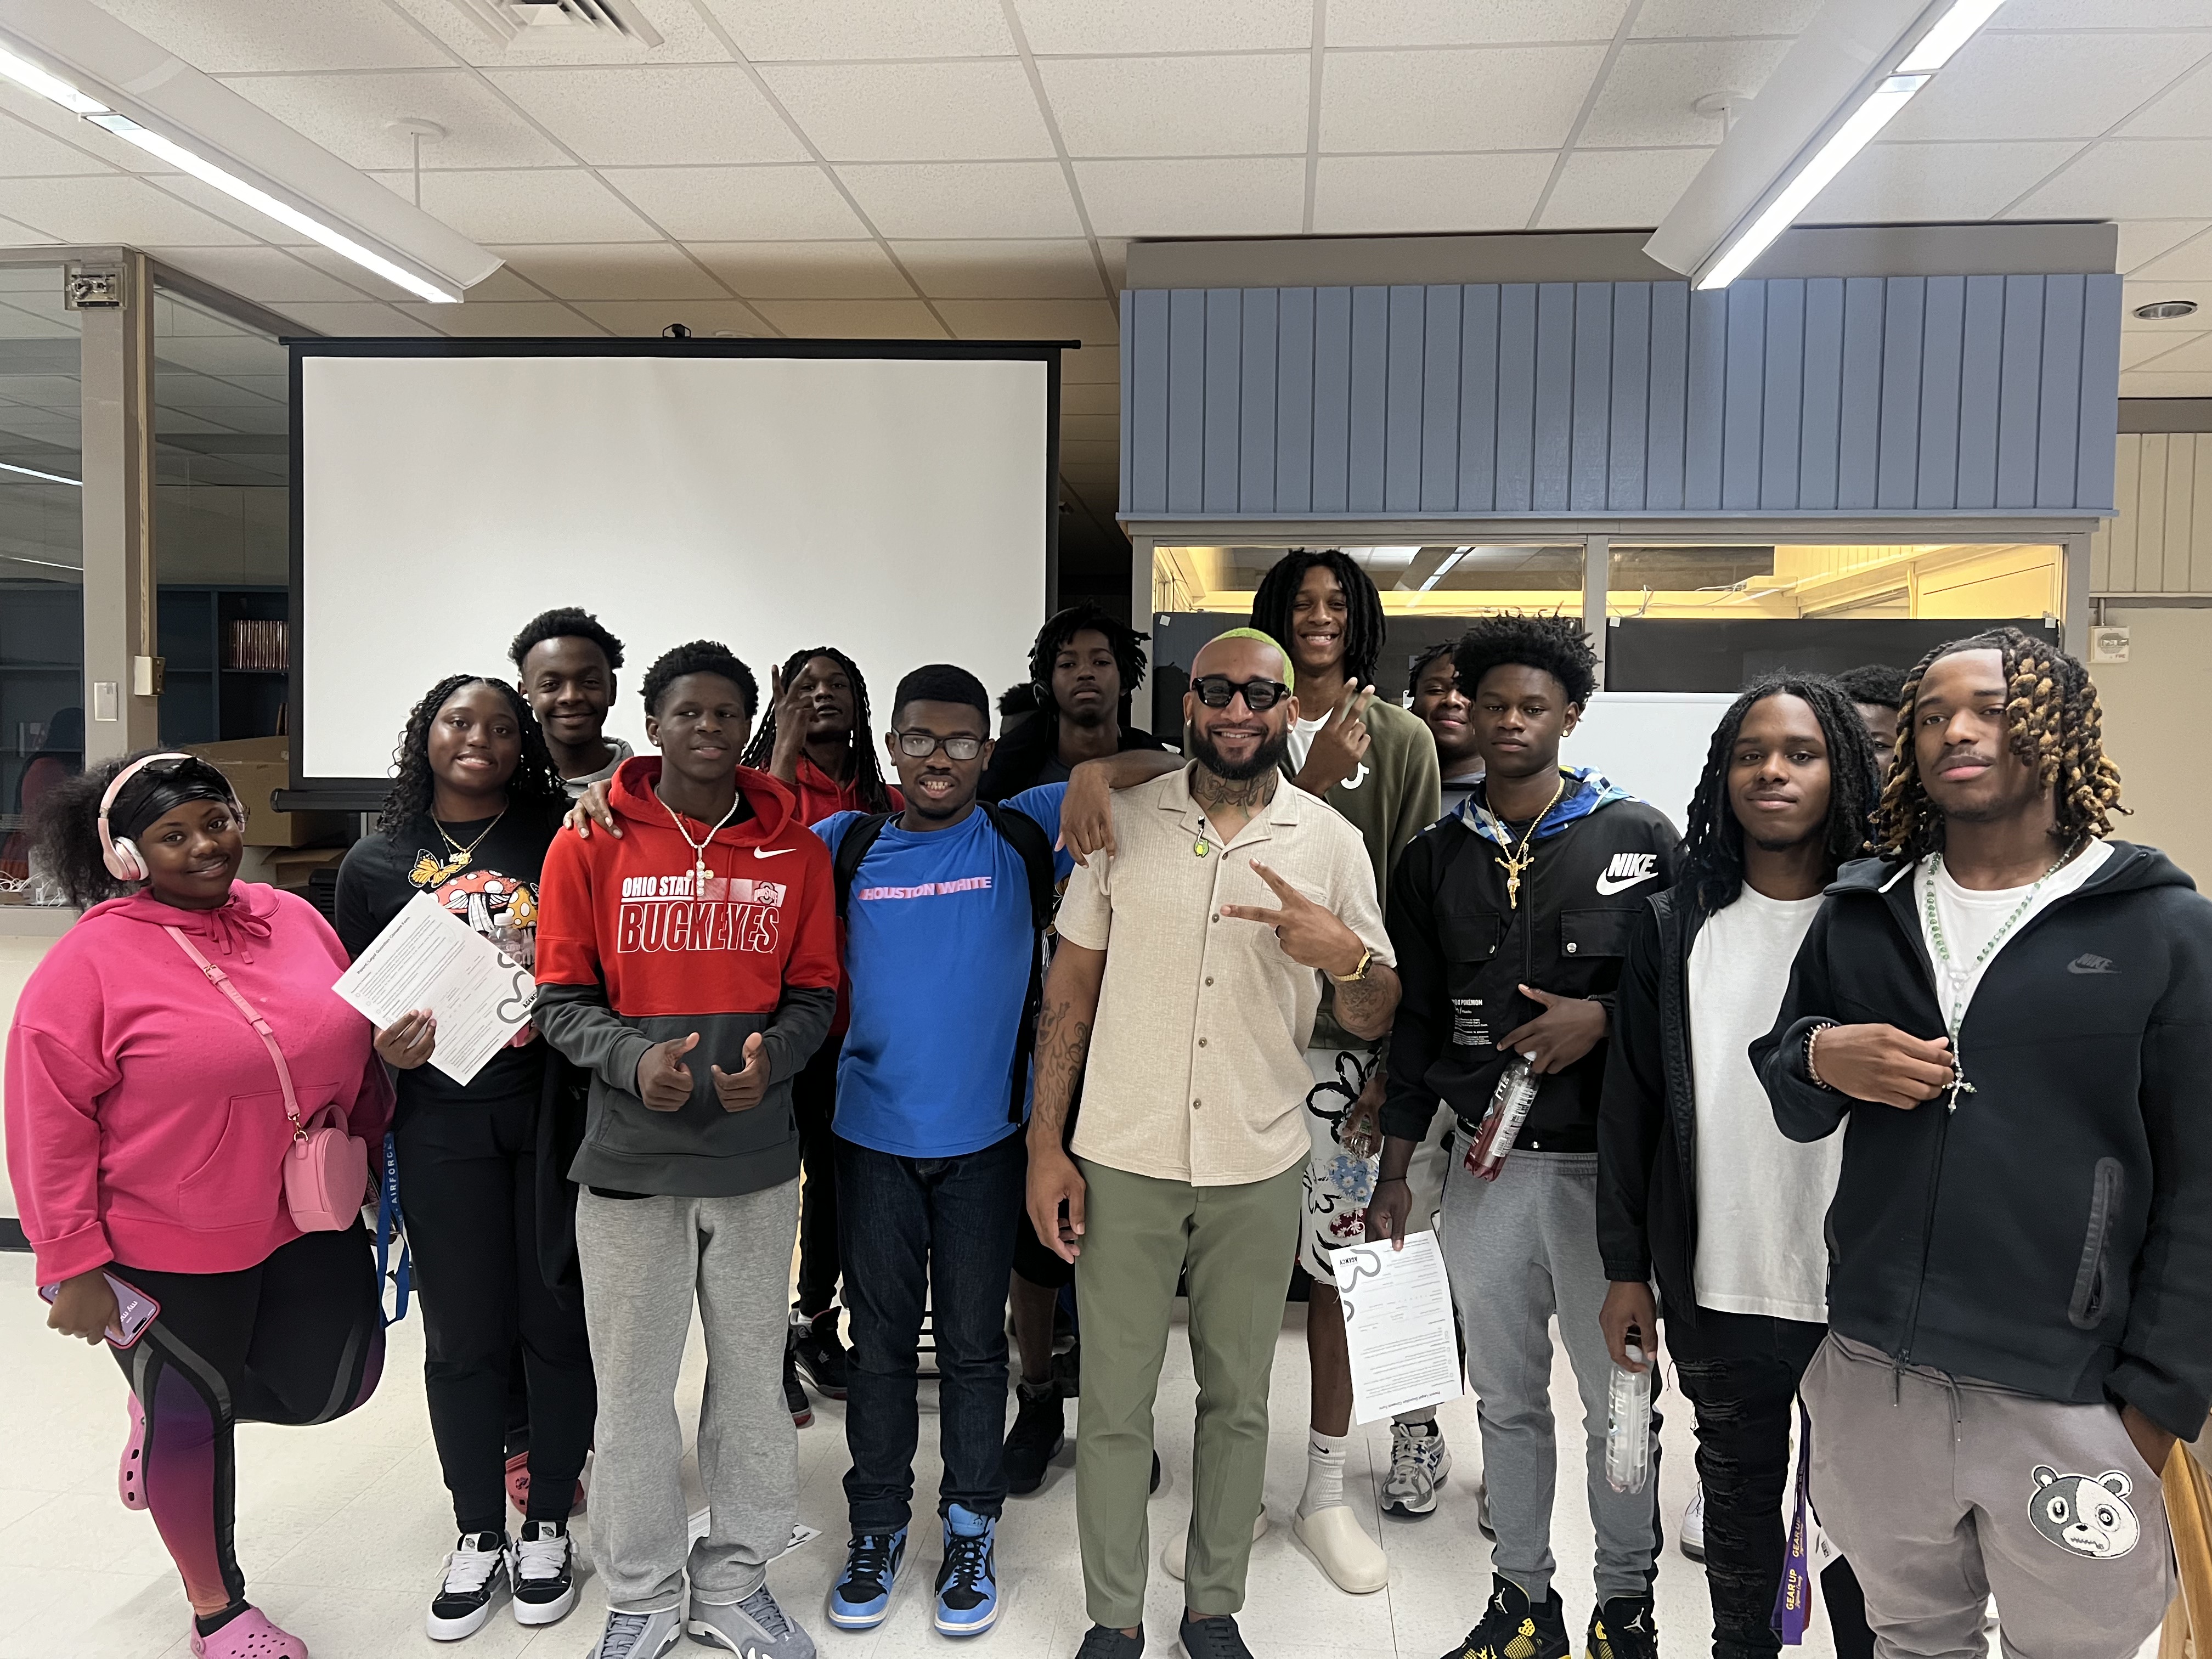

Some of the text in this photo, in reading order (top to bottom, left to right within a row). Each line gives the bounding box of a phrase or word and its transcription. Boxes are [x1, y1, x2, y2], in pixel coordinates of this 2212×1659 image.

[1607, 853, 1657, 877] NIKE
[622, 876, 657, 898] OHIO
[857, 876, 992, 900] HOUSTON WHITE
[618, 901, 780, 953] BUCKEYES
[2077, 953, 2113, 969] NIKE
[522, 991, 538, 1008] AGENC
[127, 1301, 138, 1312] my
[1792, 1516, 1801, 1558] GEAR UP
[1786, 1568, 1797, 1610] GEAR UP
